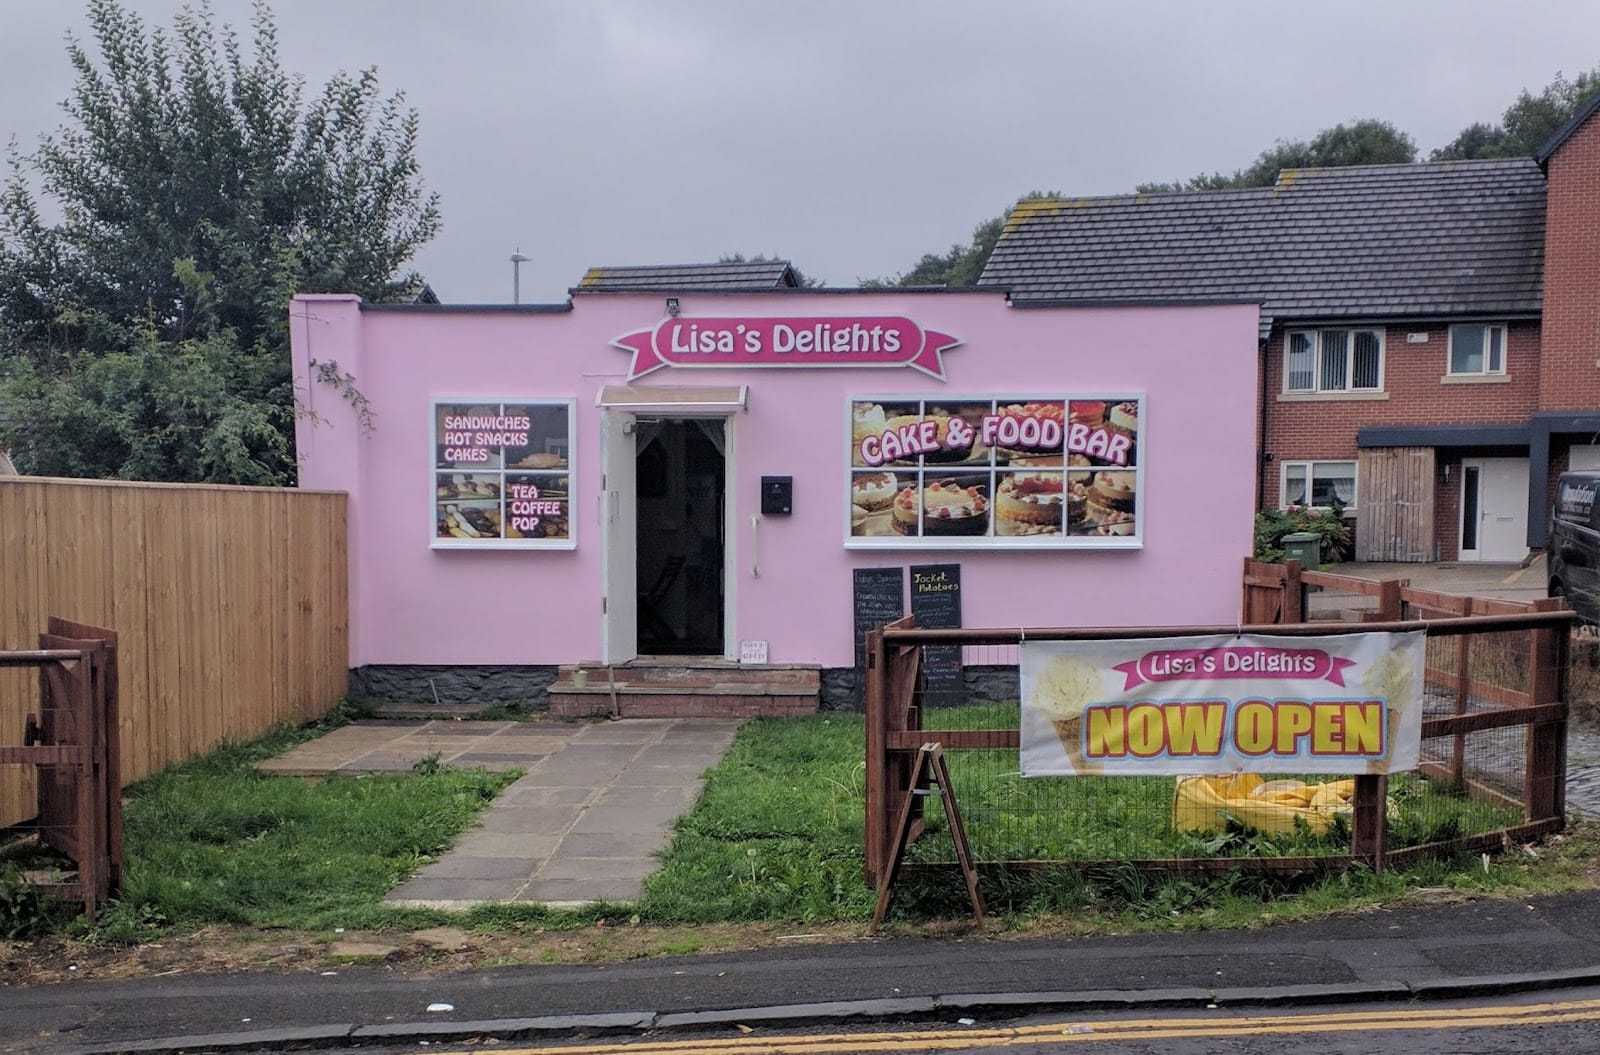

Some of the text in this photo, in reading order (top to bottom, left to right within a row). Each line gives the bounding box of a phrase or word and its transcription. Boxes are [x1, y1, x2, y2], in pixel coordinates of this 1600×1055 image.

[671, 324, 900, 353] Lisa's Delights
[444, 416, 531, 430] SANDWICHES
[444, 432, 529, 446] HOT SNACKS
[861, 415, 1132, 467] CAKE & FOOD BAR
[444, 448, 488, 461] CAKES
[512, 486, 538, 499] TEA
[512, 501, 561, 515] COFFEE
[512, 517, 539, 530] POP
[1150, 650, 1317, 676] Lisa's Delights
[1086, 699, 1384, 758] NOW OPEN
